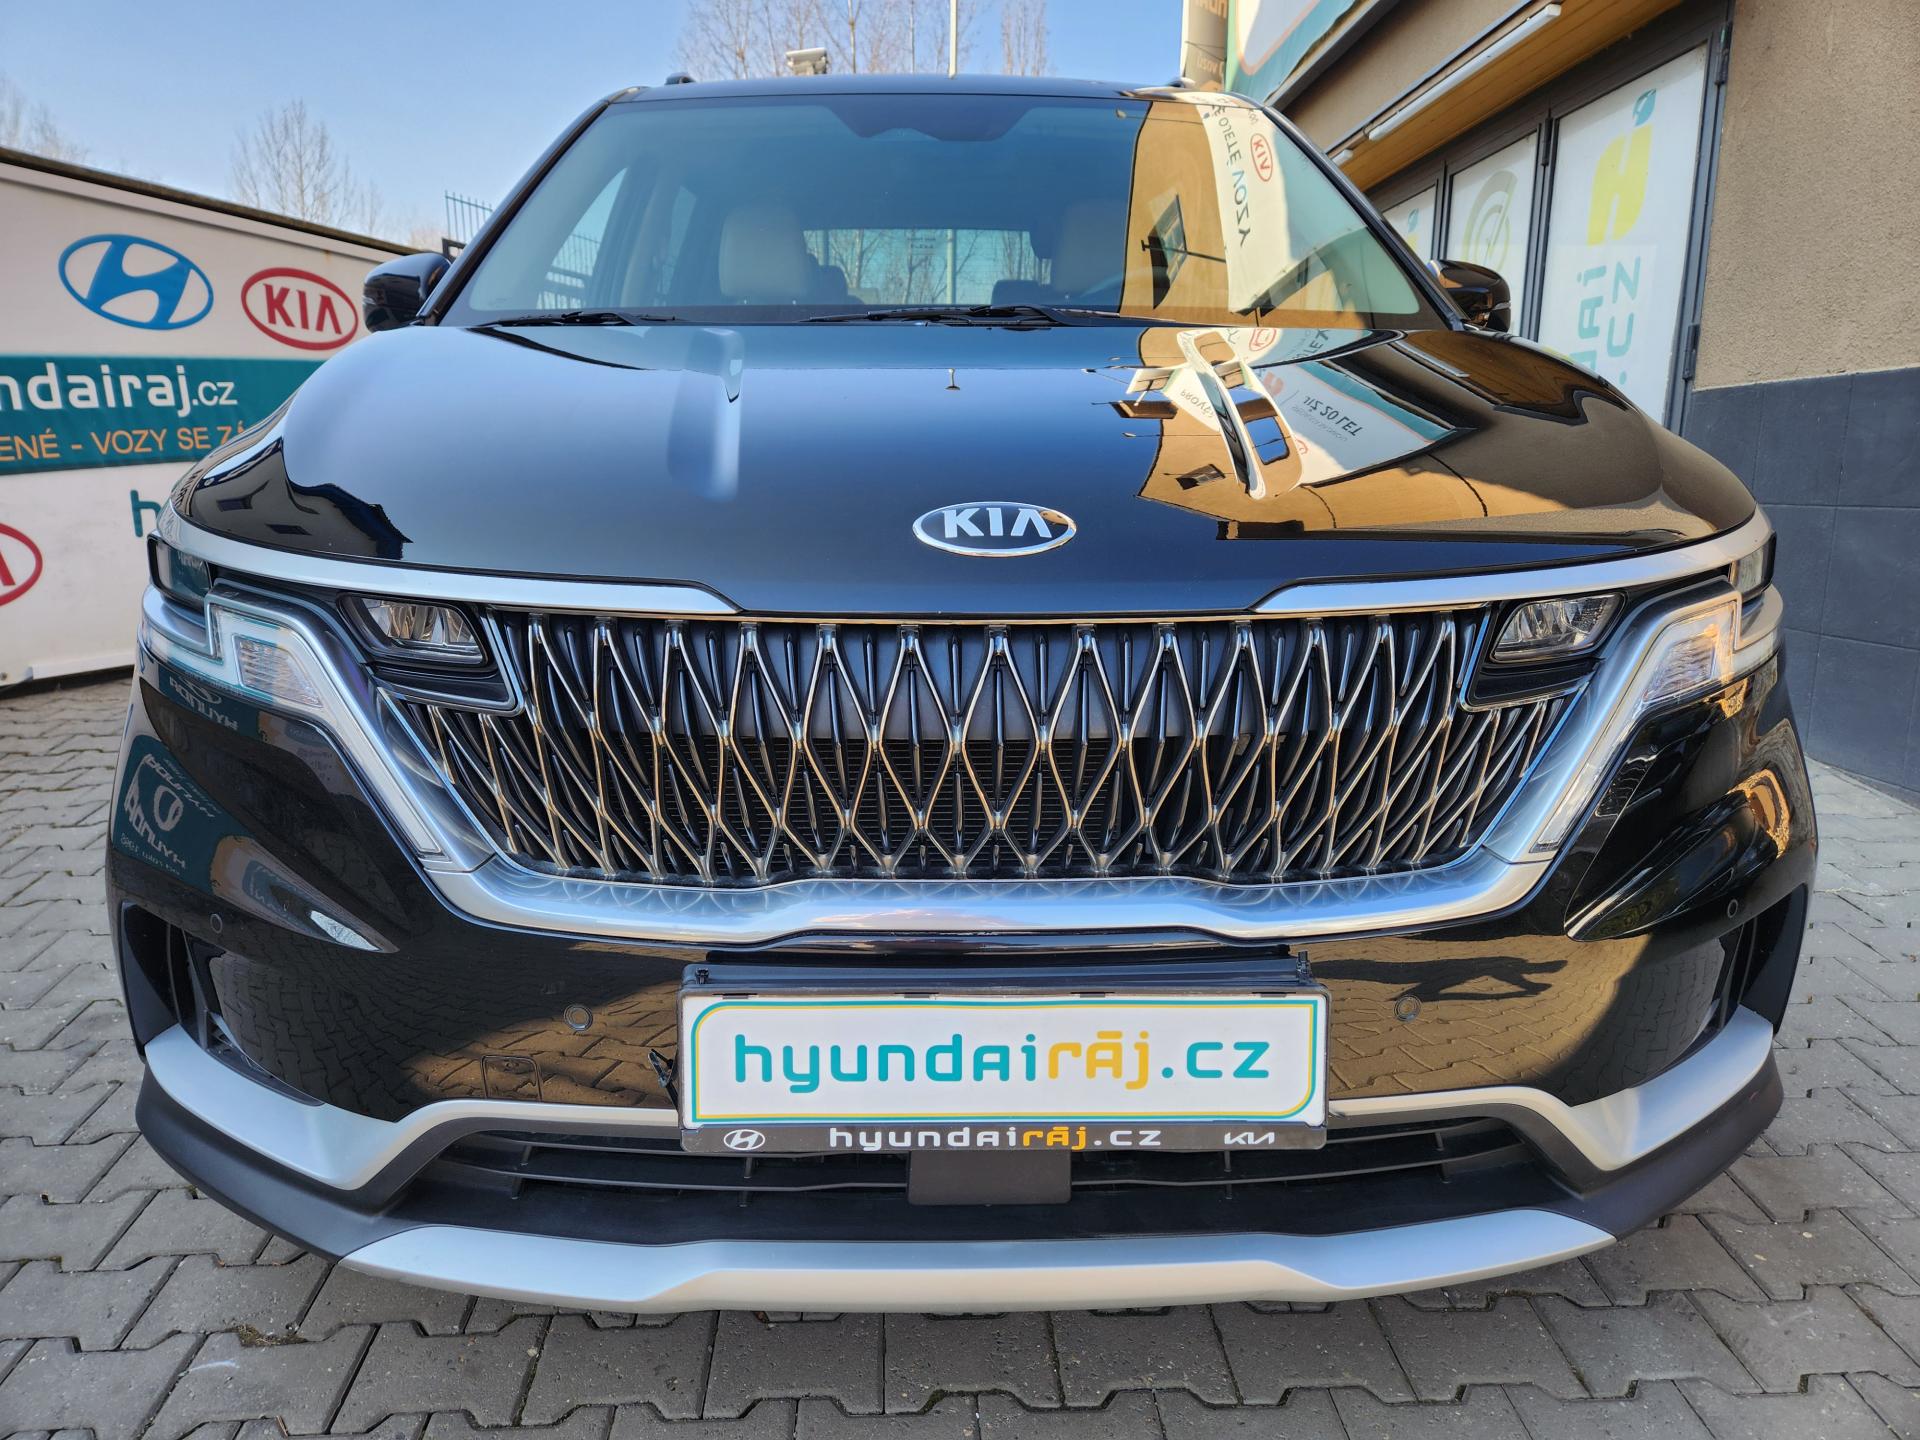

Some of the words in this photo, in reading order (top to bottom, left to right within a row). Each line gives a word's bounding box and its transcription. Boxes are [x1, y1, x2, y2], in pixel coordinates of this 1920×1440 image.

[262, 283, 342, 336] KIA
[90, 428, 168, 455] VOZY
[177, 426, 212, 450] SE
[942, 507, 1053, 539] KIA
